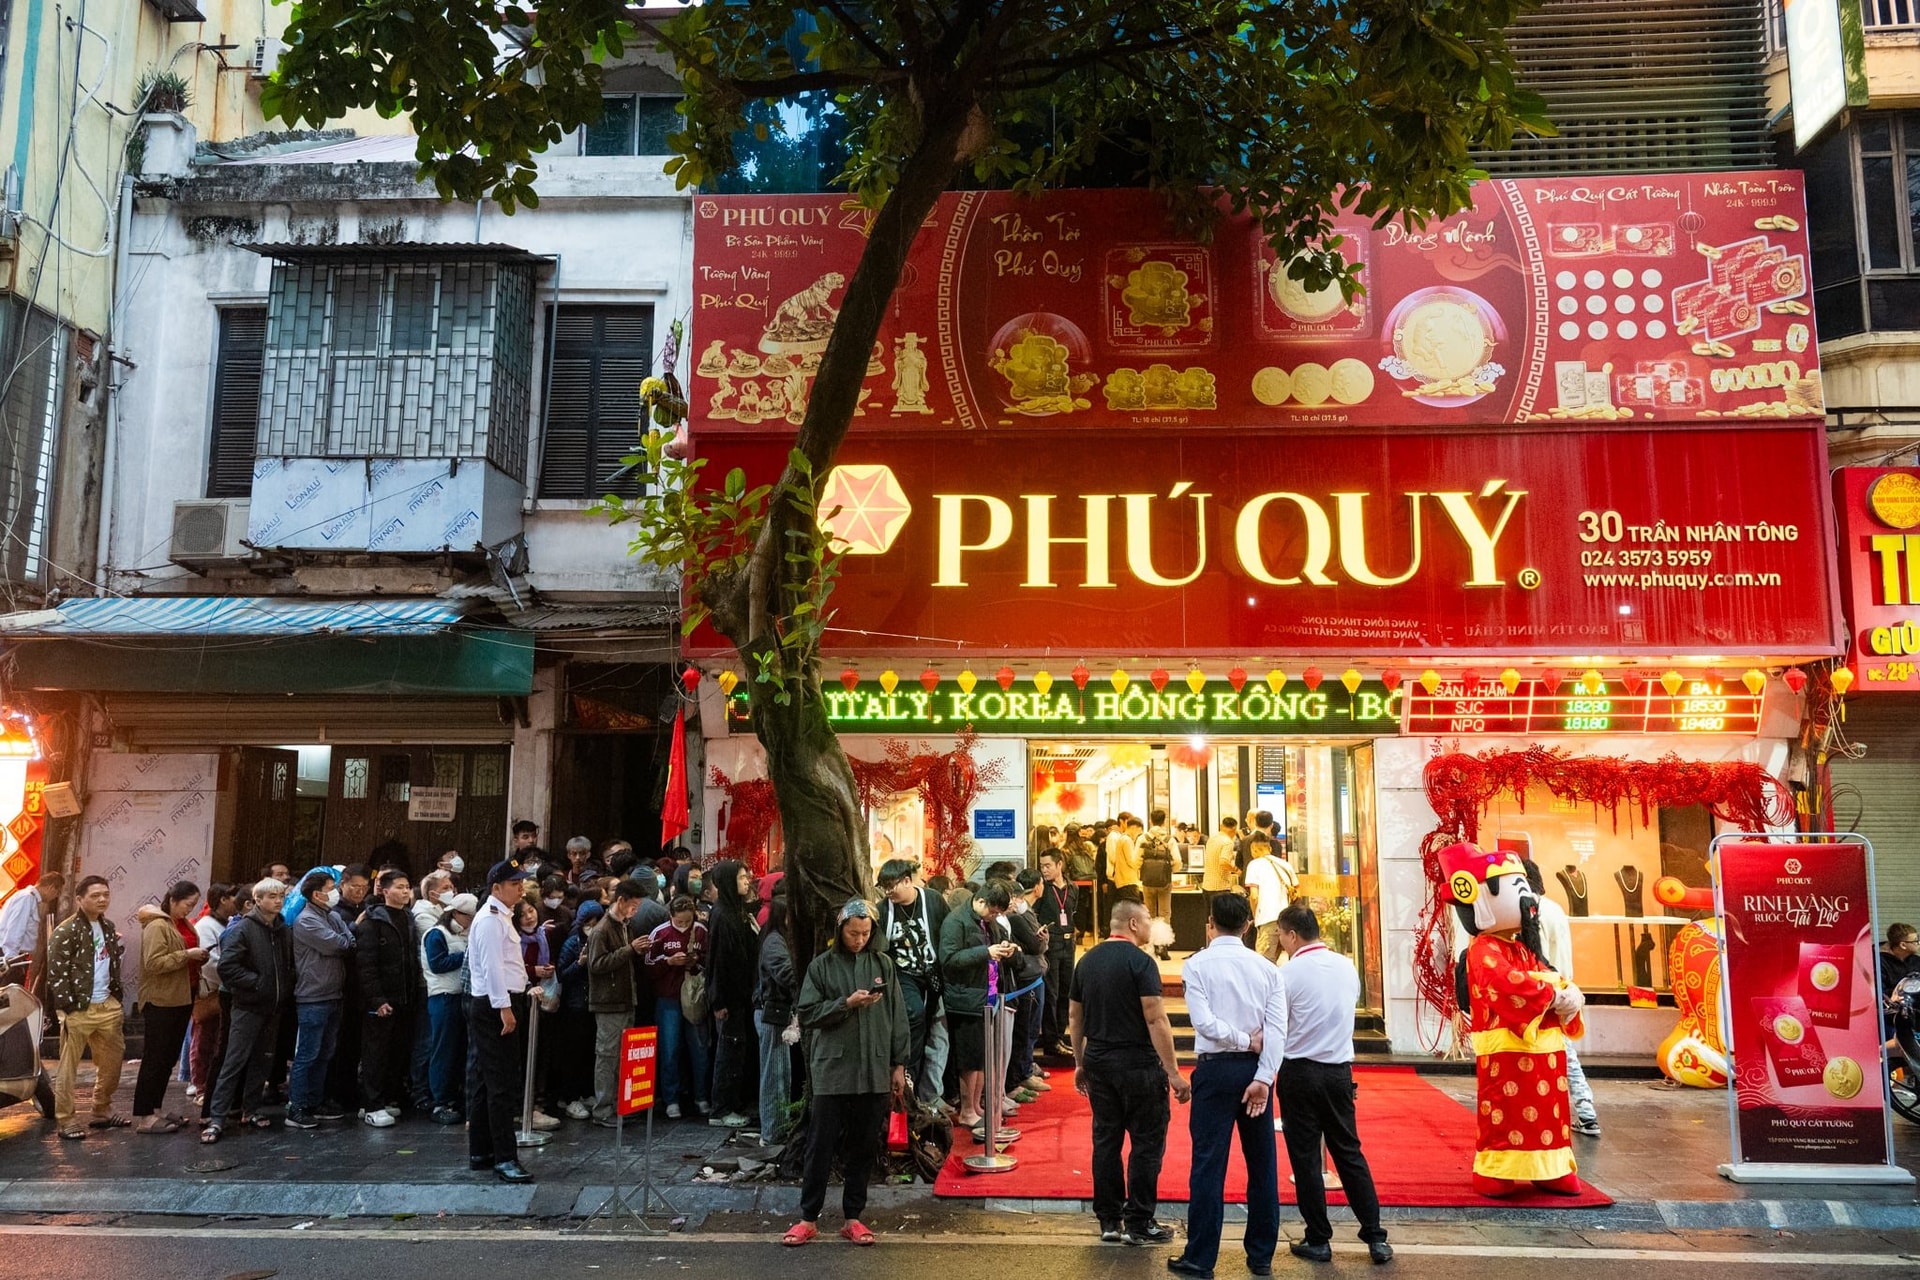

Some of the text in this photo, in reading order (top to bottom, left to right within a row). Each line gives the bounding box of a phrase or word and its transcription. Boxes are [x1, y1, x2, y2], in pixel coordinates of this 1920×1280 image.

[723, 205, 833, 226] PHÚ QUÝ
[994, 249, 1084, 283] Phú Quý
[741, 265, 771, 291] Vàng
[701, 293, 733, 309] Phú
[931, 481, 1213, 588] PHÚ
[1235, 479, 1529, 588] QUÝ
[1578, 511, 1799, 543] 30 TRẦN NHÂN TÔNG
[1581, 550, 1712, 567] 024 3573 5959
[1583, 570, 1781, 591] www.phuquy.com.vn
[1574, 682, 1607, 695] MA
[826, 691, 943, 724] ITALY,
[949, 692, 1086, 724] KOREA,
[1212, 684, 1328, 720] KÔNG
[1455, 701, 1484, 714] SJC
[1451, 719, 1485, 732] NPQ
[27, 792, 40, 813] 3
[1743, 893, 1850, 912] RINH VÀNG
[1771, 1118, 1789, 1127] PHÚ
[1789, 1119, 1807, 1128] QUÝ
